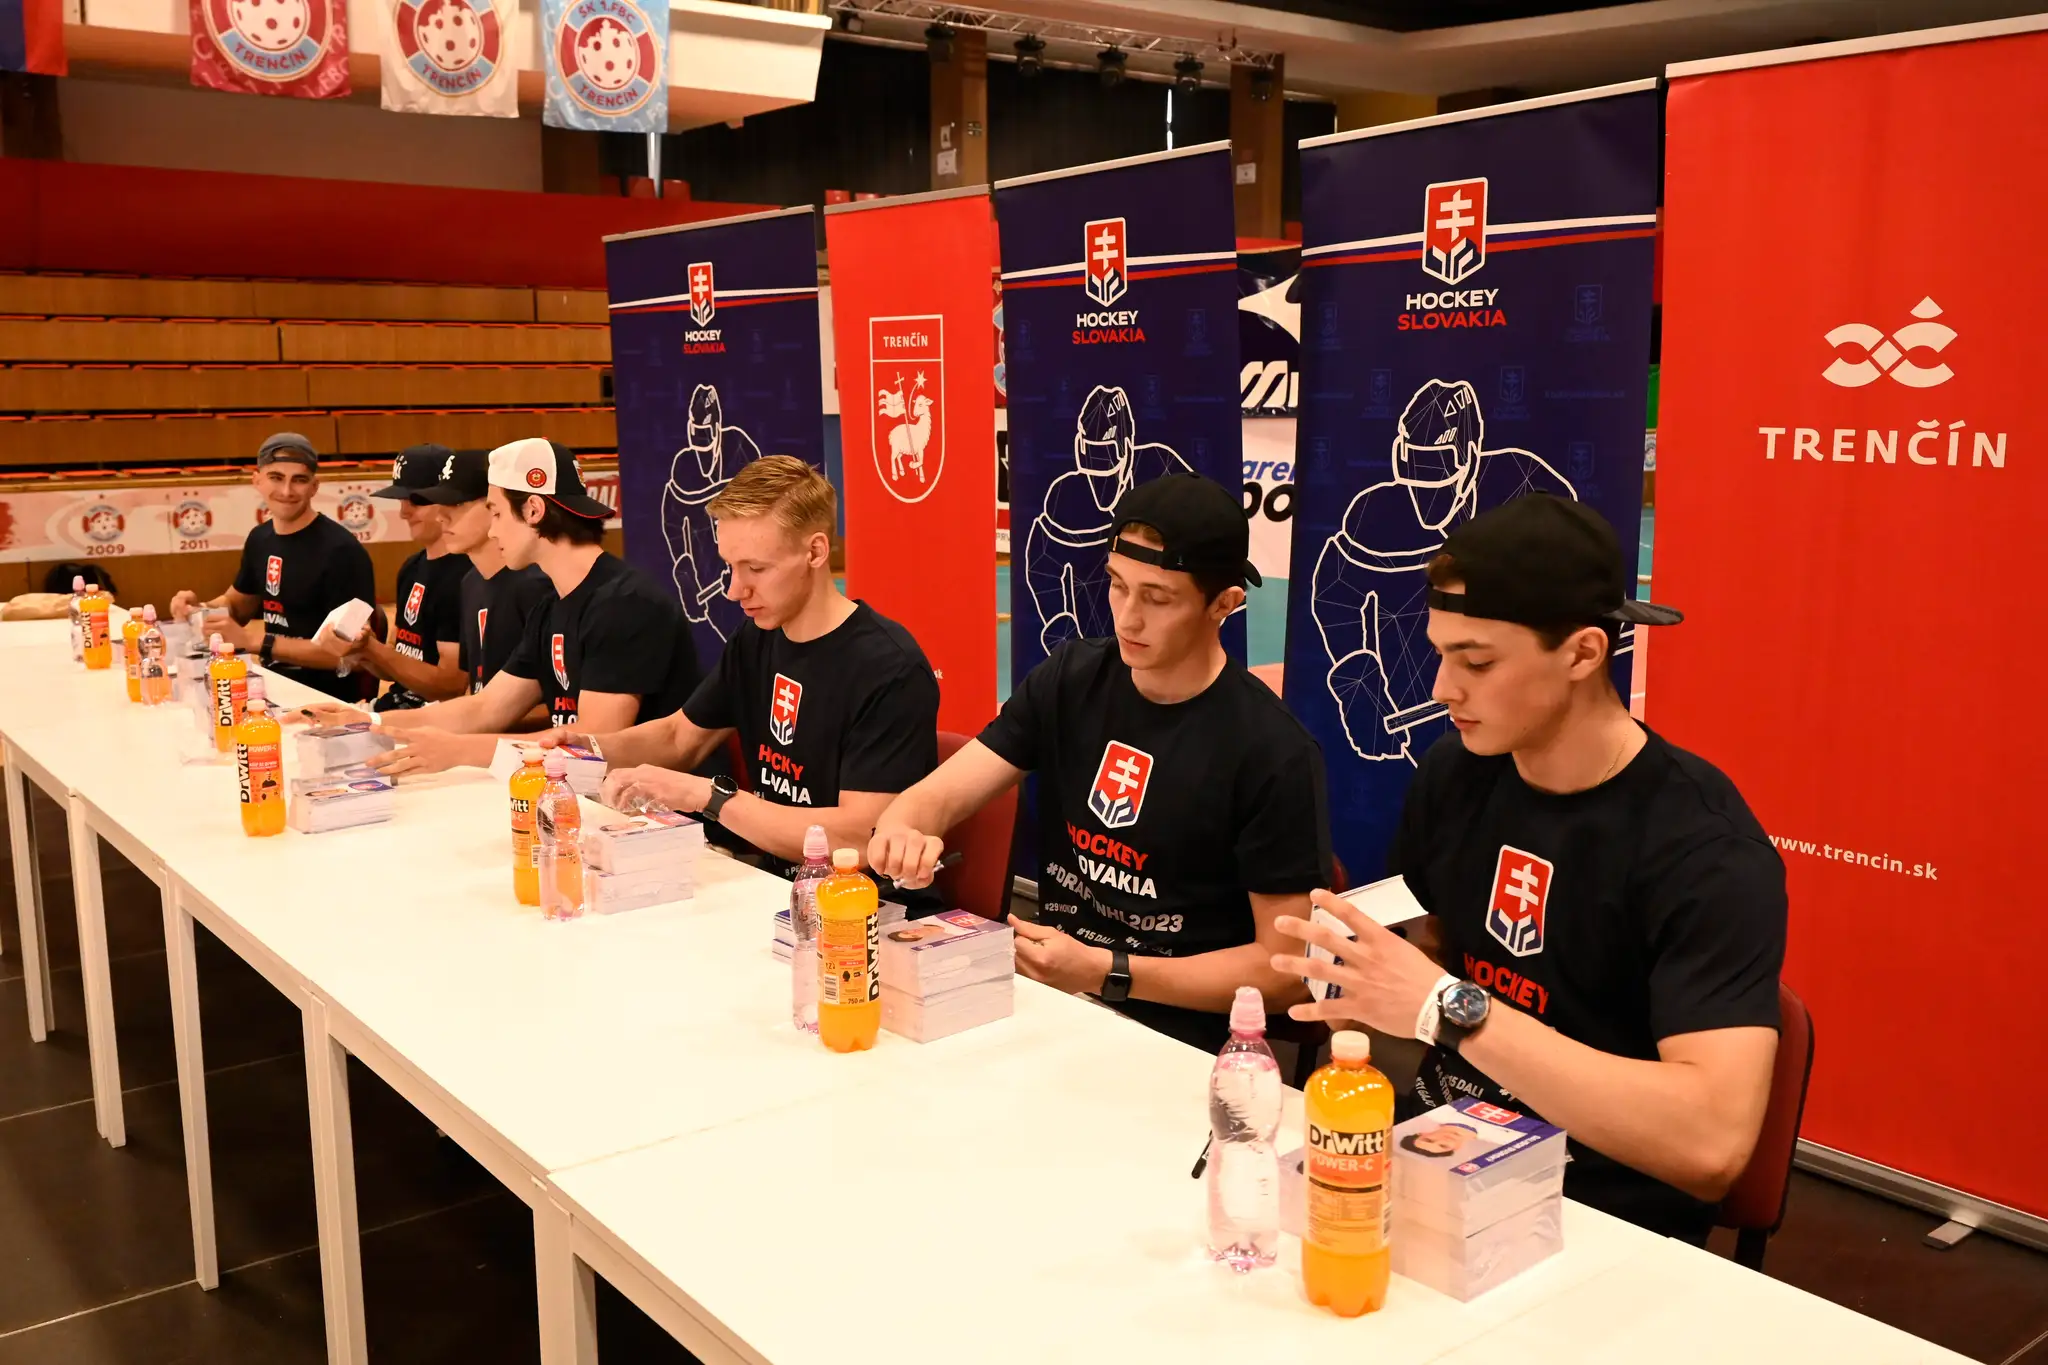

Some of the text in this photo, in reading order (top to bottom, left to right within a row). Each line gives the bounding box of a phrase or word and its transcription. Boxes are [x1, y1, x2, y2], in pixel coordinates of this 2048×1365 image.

[1405, 288, 1499, 311] HOCKEY
[1076, 310, 1139, 328] HOCKEY
[1397, 309, 1507, 331] SLOVAKIA
[685, 329, 721, 342] HOCKEY
[883, 332, 929, 348] TRENČÍN
[1072, 326, 1146, 345] SLOVAKIA
[683, 342, 726, 354] SLOVAKIA
[1758, 418, 2007, 468] TRENČÍN
[1242, 460, 1296, 482] are
[86, 543, 125, 556] 2009
[180, 539, 209, 550] 2011
[1066, 820, 1148, 871] HOCKEY
[1768, 834, 1938, 880] www.trencin.sk
[1073, 848, 1158, 899] OVAKIA
[1463, 952, 1550, 1015] HOCKEY
[1456, 1079, 1485, 1099] DALI
